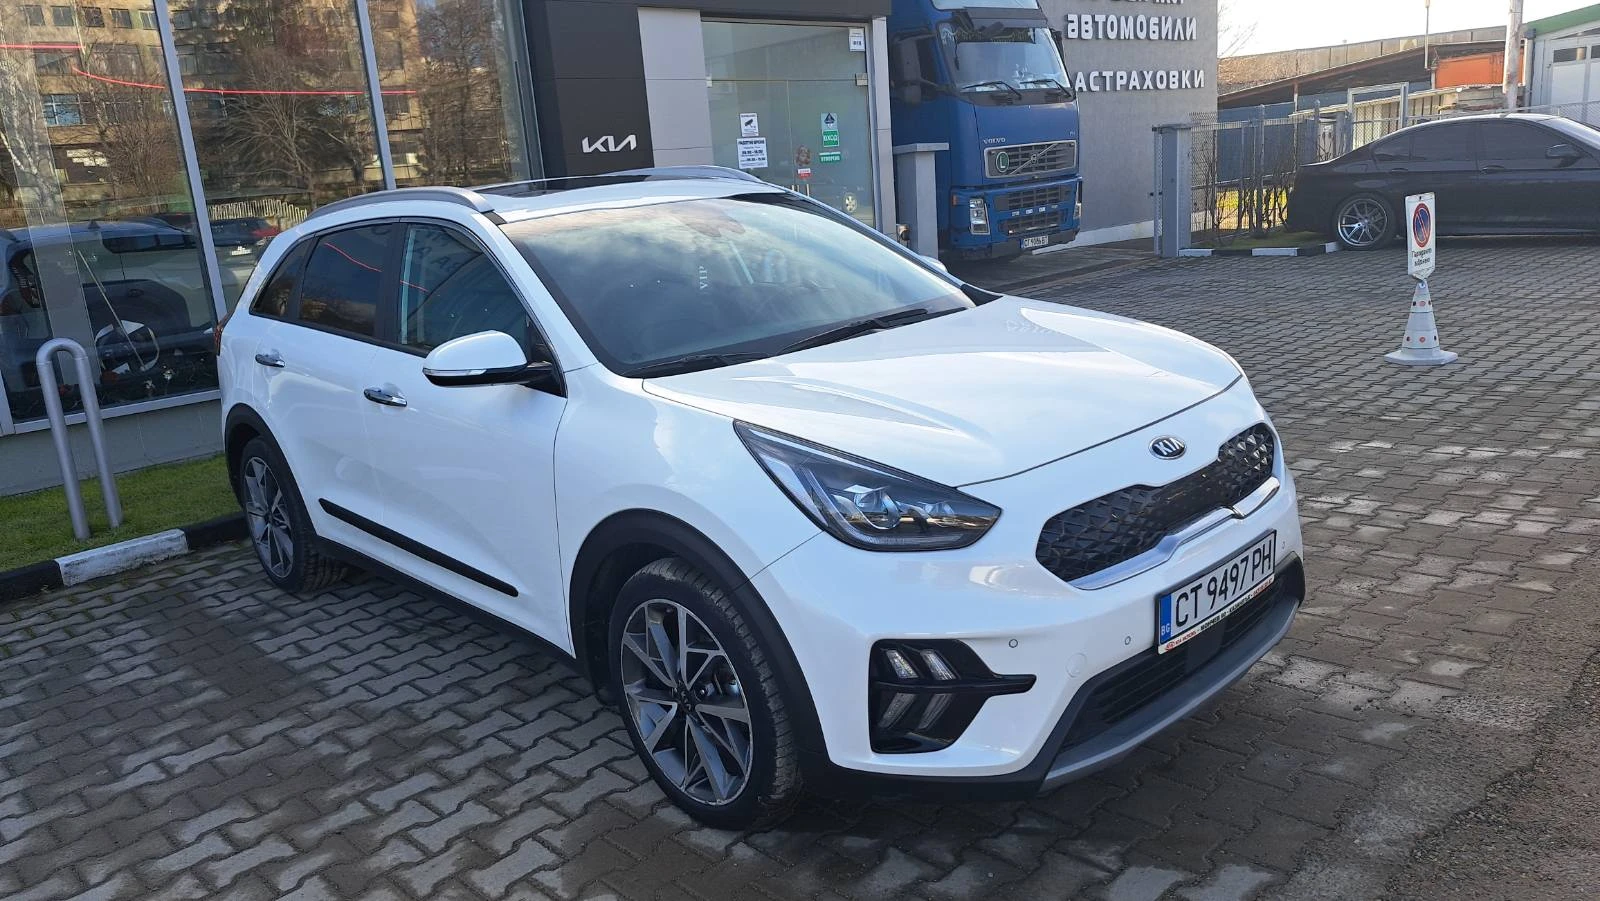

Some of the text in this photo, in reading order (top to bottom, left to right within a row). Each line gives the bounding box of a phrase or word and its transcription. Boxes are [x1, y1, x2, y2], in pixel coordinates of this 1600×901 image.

[1074, 69, 1205, 92] АСТРАХОВКИ
[582, 134, 637, 153] KIA
[983, 137, 1006, 145] VOLVO
[1153, 437, 1185, 456] KIA
[1175, 582, 1203, 628] CT
[1207, 555, 1250, 610] 9497
[1252, 539, 1272, 581] PH
[1161, 623, 1171, 636] BG
